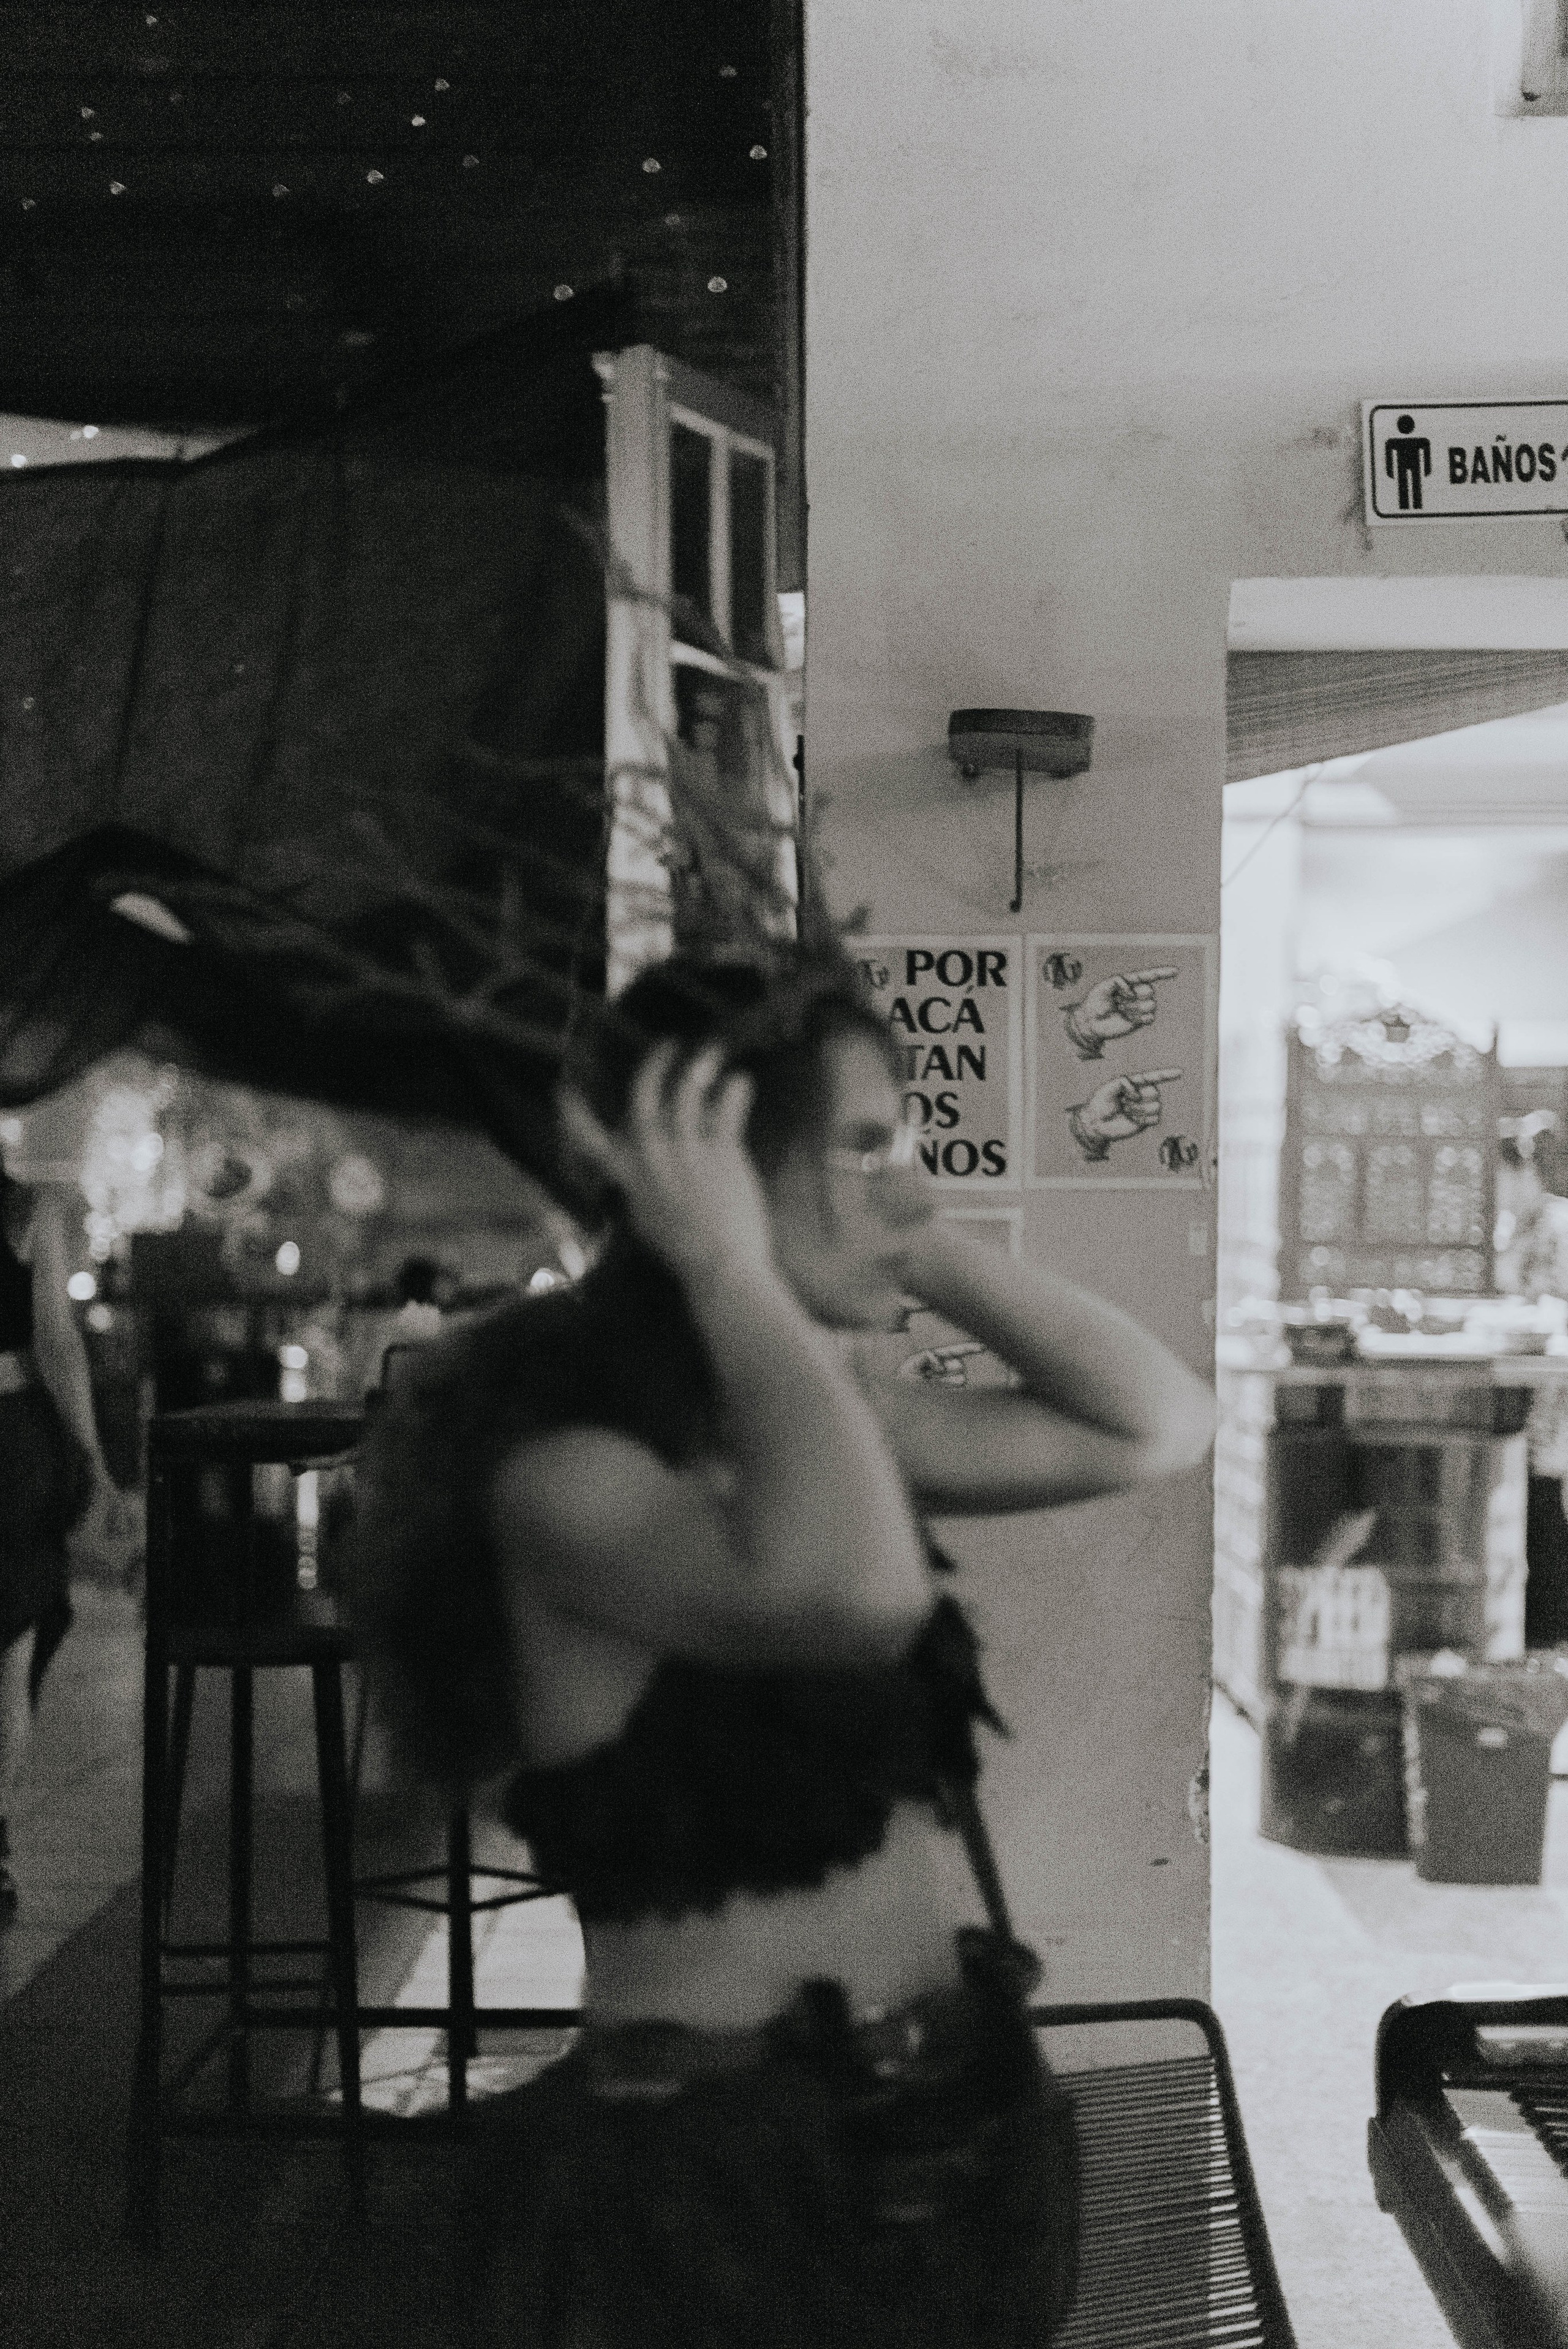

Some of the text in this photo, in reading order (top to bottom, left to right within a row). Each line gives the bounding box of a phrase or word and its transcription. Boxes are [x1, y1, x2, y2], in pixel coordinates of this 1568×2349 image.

[1448, 434, 1557, 485] BAÑOS
[907, 950, 1006, 987] POR
[890, 985, 984, 1034] ACÁ
[901, 1045, 986, 1080] TAN
[902, 1092, 960, 1129] OS
